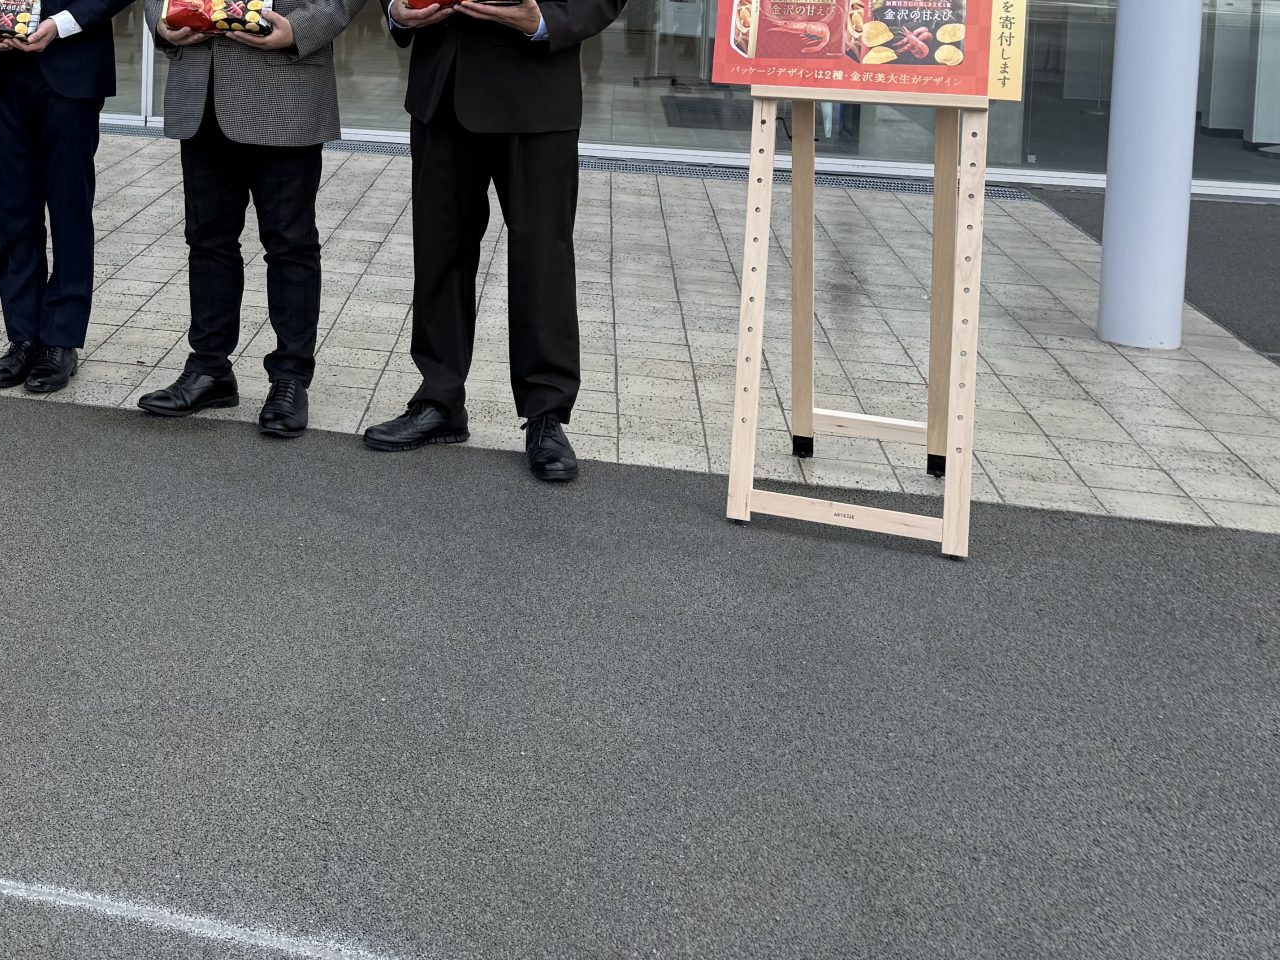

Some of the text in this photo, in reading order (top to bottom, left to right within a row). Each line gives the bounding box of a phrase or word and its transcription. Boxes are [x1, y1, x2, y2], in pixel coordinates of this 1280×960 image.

[771, 5, 836, 16] 金沢の甘えび
[883, 9, 953, 21] 金沢の甘えび
